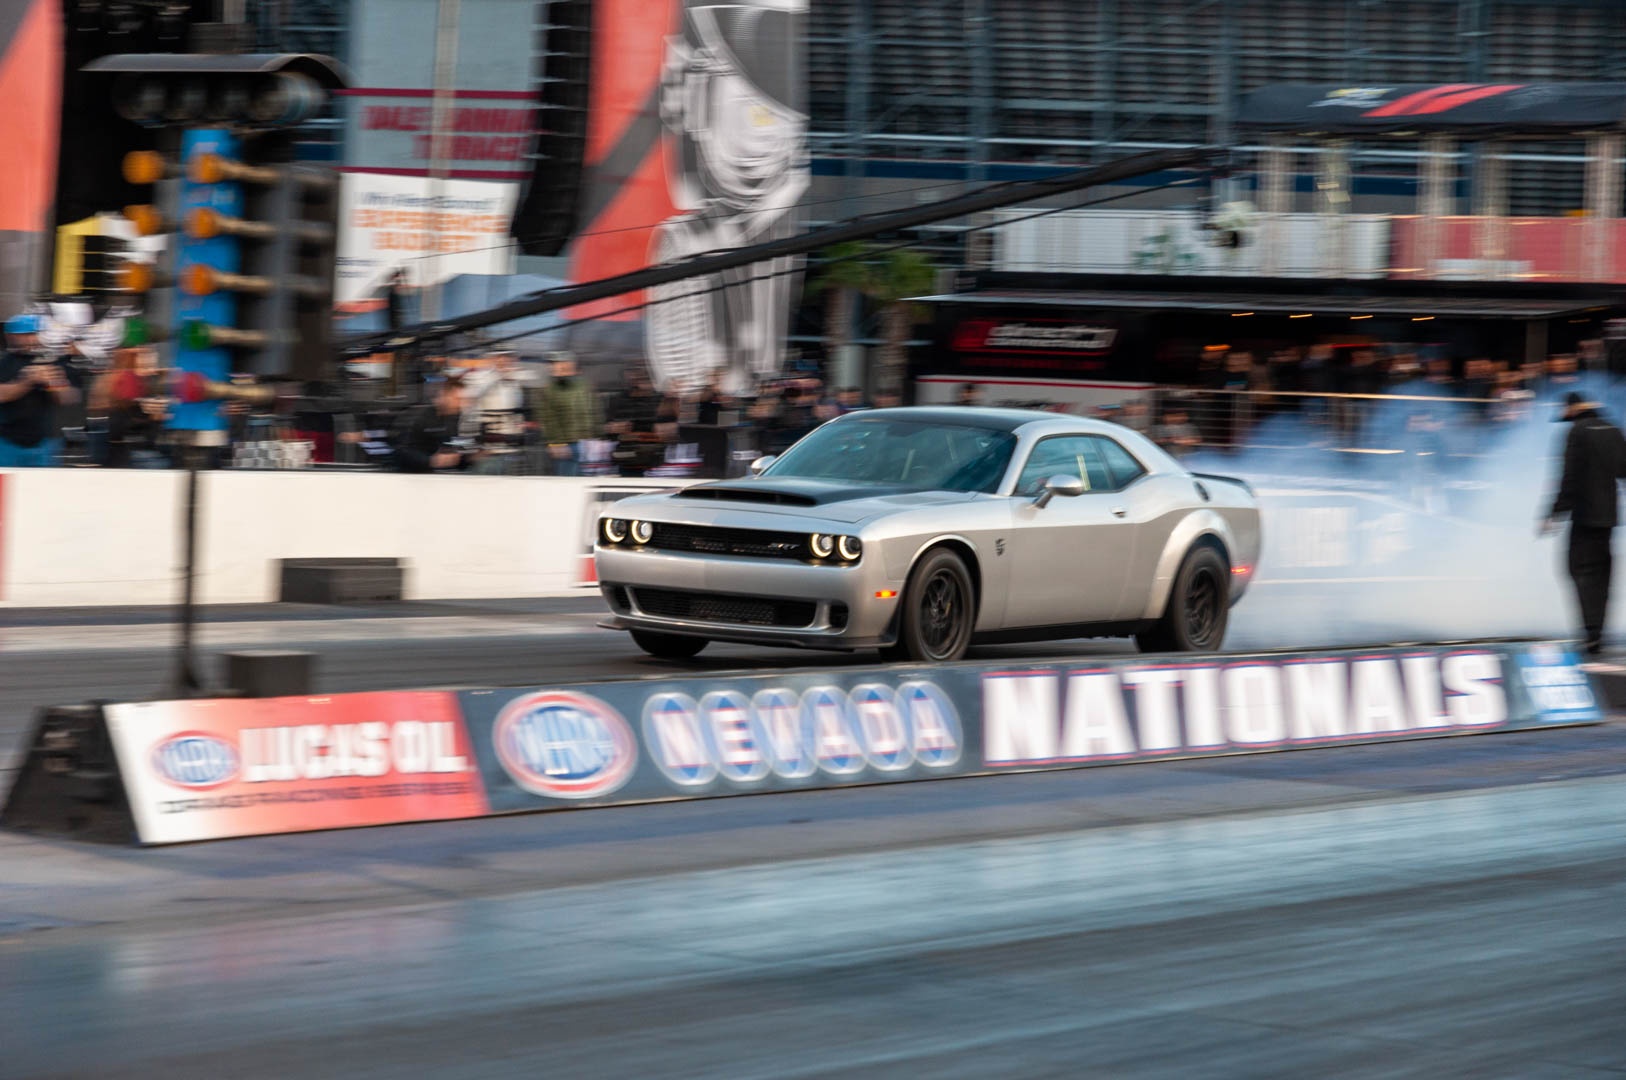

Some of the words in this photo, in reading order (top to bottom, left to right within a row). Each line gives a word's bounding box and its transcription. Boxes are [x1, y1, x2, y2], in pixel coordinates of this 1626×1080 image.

[650, 694, 959, 771] NEVADA
[983, 651, 1507, 767] NATIONALS
[240, 721, 390, 783] LUCAS
[392, 720, 469, 775] OIL
